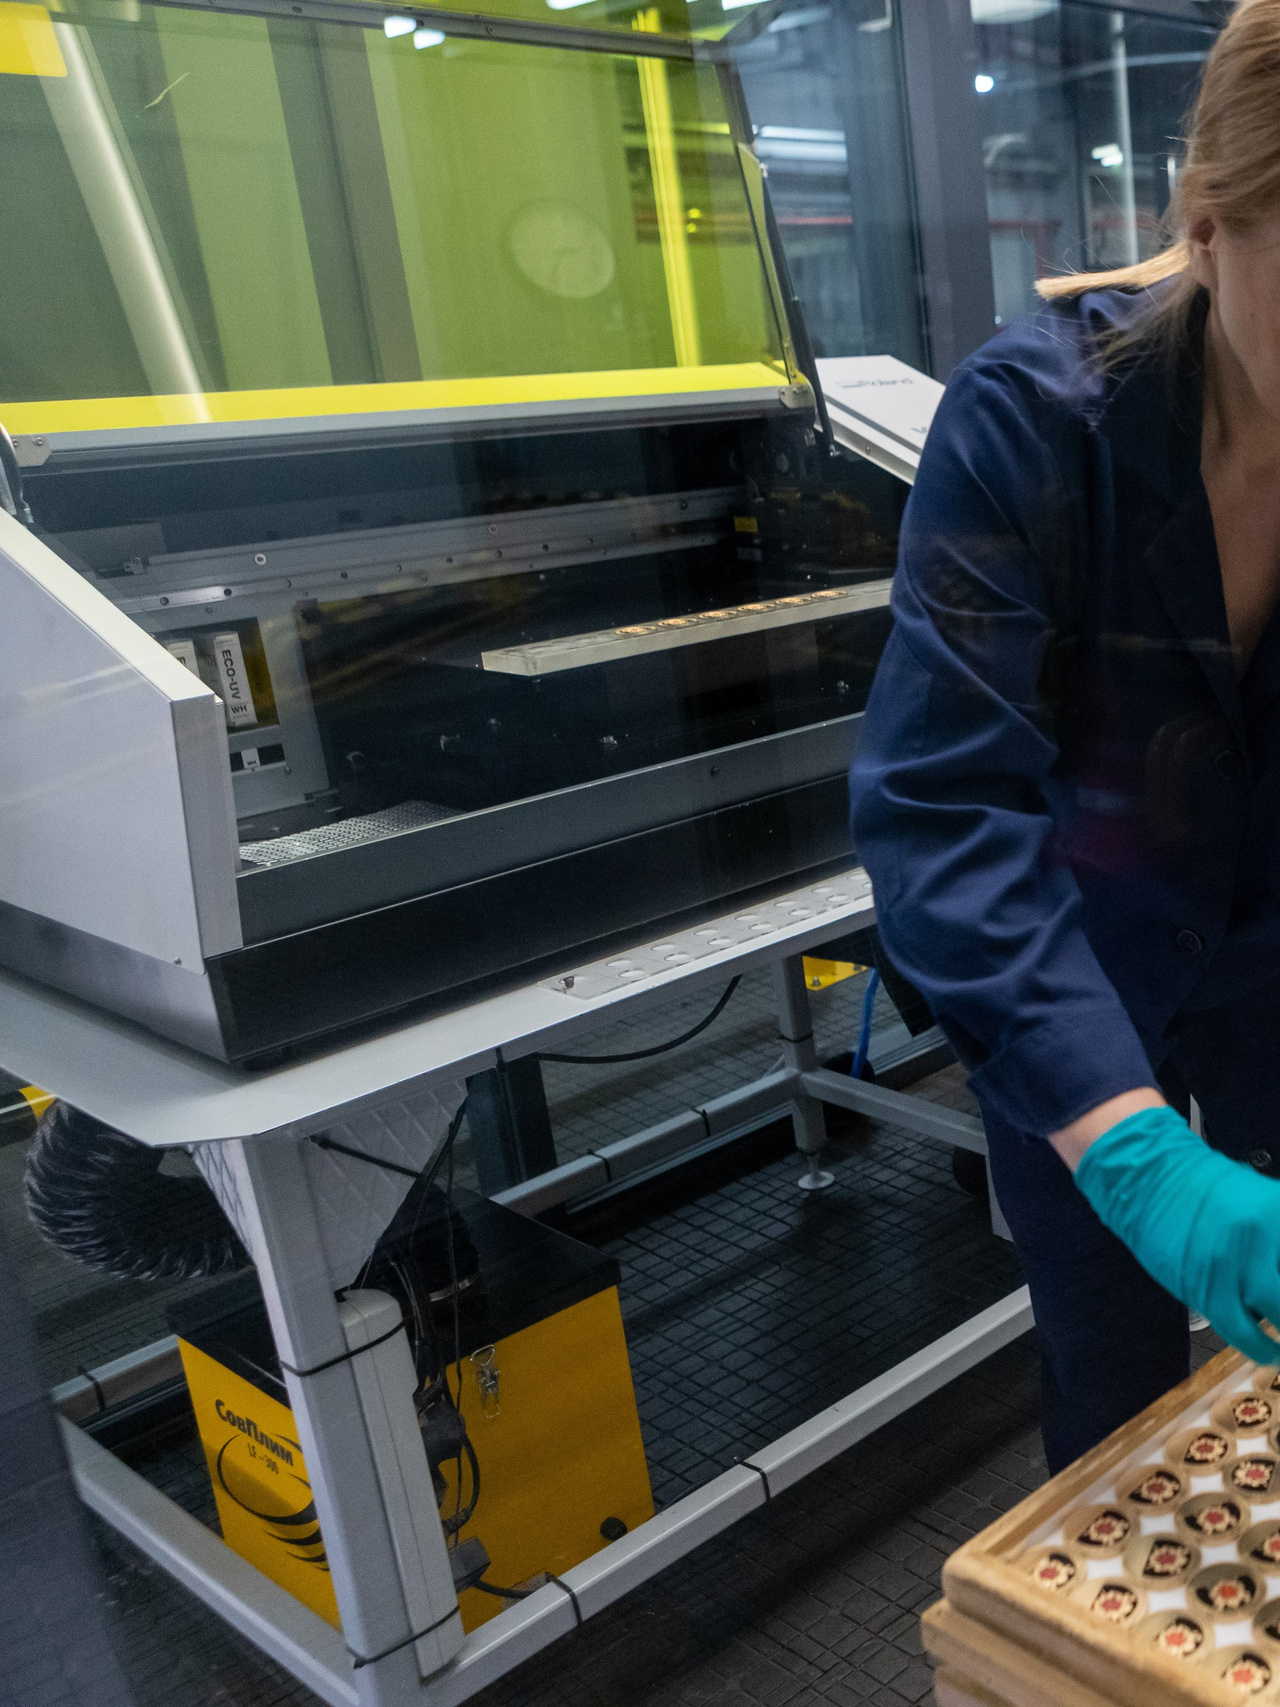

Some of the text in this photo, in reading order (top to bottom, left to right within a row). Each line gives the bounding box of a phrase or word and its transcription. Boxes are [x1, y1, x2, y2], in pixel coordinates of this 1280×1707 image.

[222, 649, 241, 700] ECO-UV
[231, 705, 248, 714] WH
[214, 1398, 295, 1467] СовПлим
